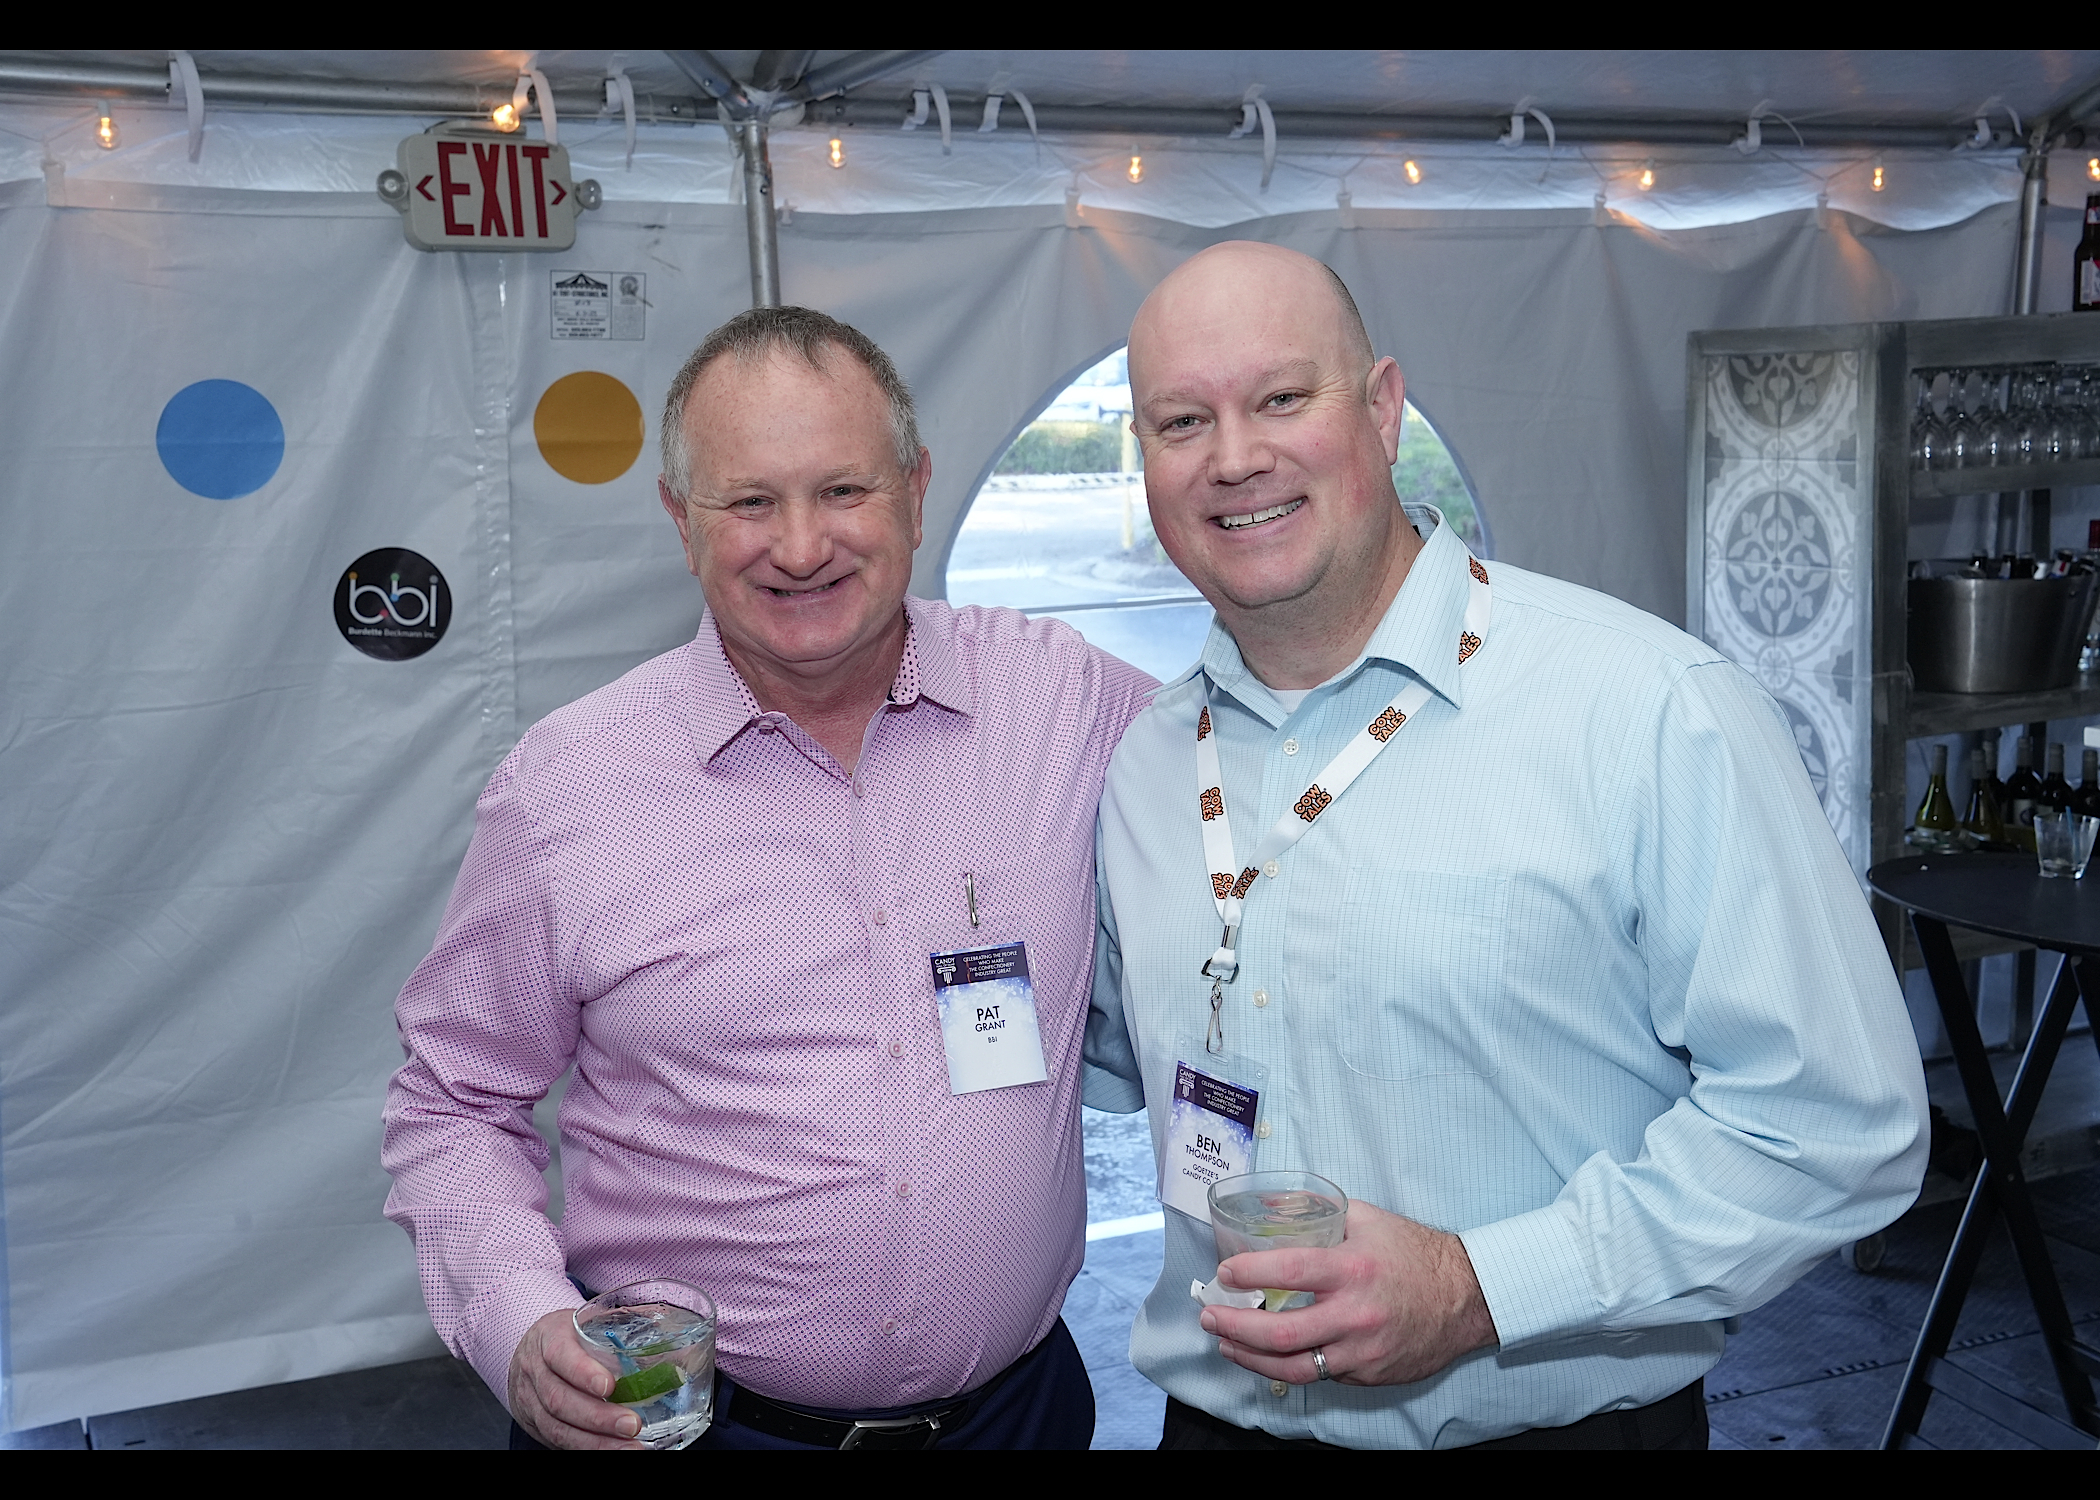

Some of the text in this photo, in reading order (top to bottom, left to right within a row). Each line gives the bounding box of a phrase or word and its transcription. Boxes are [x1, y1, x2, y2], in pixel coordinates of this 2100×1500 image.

[437, 141, 550, 238] EXIT
[348, 571, 438, 628] bbi
[348, 626, 382, 636] Burdette
[1458, 634, 1481, 665] ALES
[1368, 706, 1396, 735] COW
[1374, 712, 1406, 742] TALES
[1200, 789, 1214, 821] TALES
[1209, 787, 1223, 815] COW
[1293, 784, 1321, 815] COW
[1300, 791, 1332, 822] TALES
[1222, 874, 1234, 898] CO
[1236, 870, 1259, 899] TALES
[935, 957, 955, 965] CANDY
[963, 954, 992, 962] CELEBRATING
[978, 962, 1015, 971] CONFECTIONERY
[976, 1005, 1000, 1021] PAT
[975, 1019, 1006, 1032] GRANT
[1180, 1069, 1196, 1080] CANDY
[1201, 1080, 1227, 1094] CELEBRATING
[1227, 1090, 1235, 1098] THE
[1204, 1092, 1212, 1100] THE
[1212, 1090, 1236, 1104] WHO MAKE
[1207, 1100, 1240, 1116] INDUSTRY GREAT
[1196, 1134, 1221, 1156] BEN
[1185, 1144, 1230, 1171] THOMPSON
[1182, 1168, 1202, 1181] CANDY
[1192, 1163, 1219, 1180] GOETZE'S
